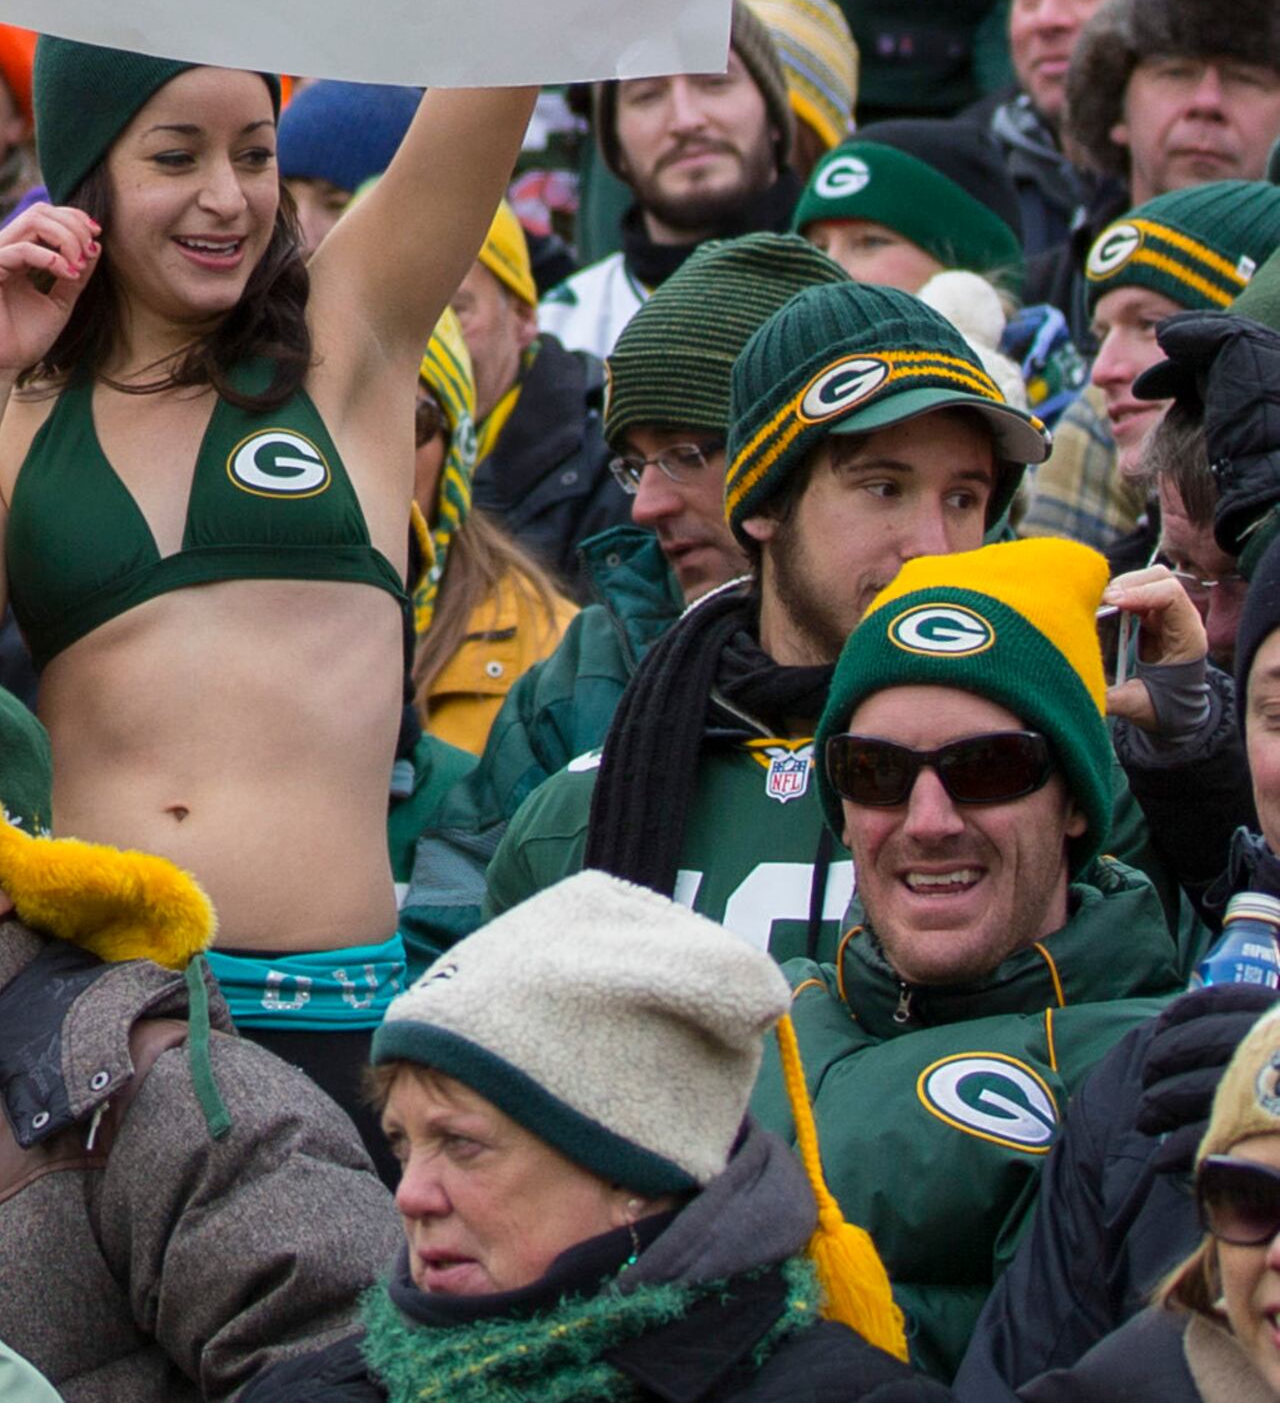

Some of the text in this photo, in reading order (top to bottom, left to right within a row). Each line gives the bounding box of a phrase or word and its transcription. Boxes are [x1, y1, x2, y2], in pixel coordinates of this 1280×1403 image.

[813, 156, 870, 199] G
[1089, 224, 1139, 273] G
[802, 356, 890, 420] G
[231, 431, 326, 494] G
[893, 607, 990, 655] G
[771, 773, 801, 793] NFL
[922, 1054, 1056, 1152] G
